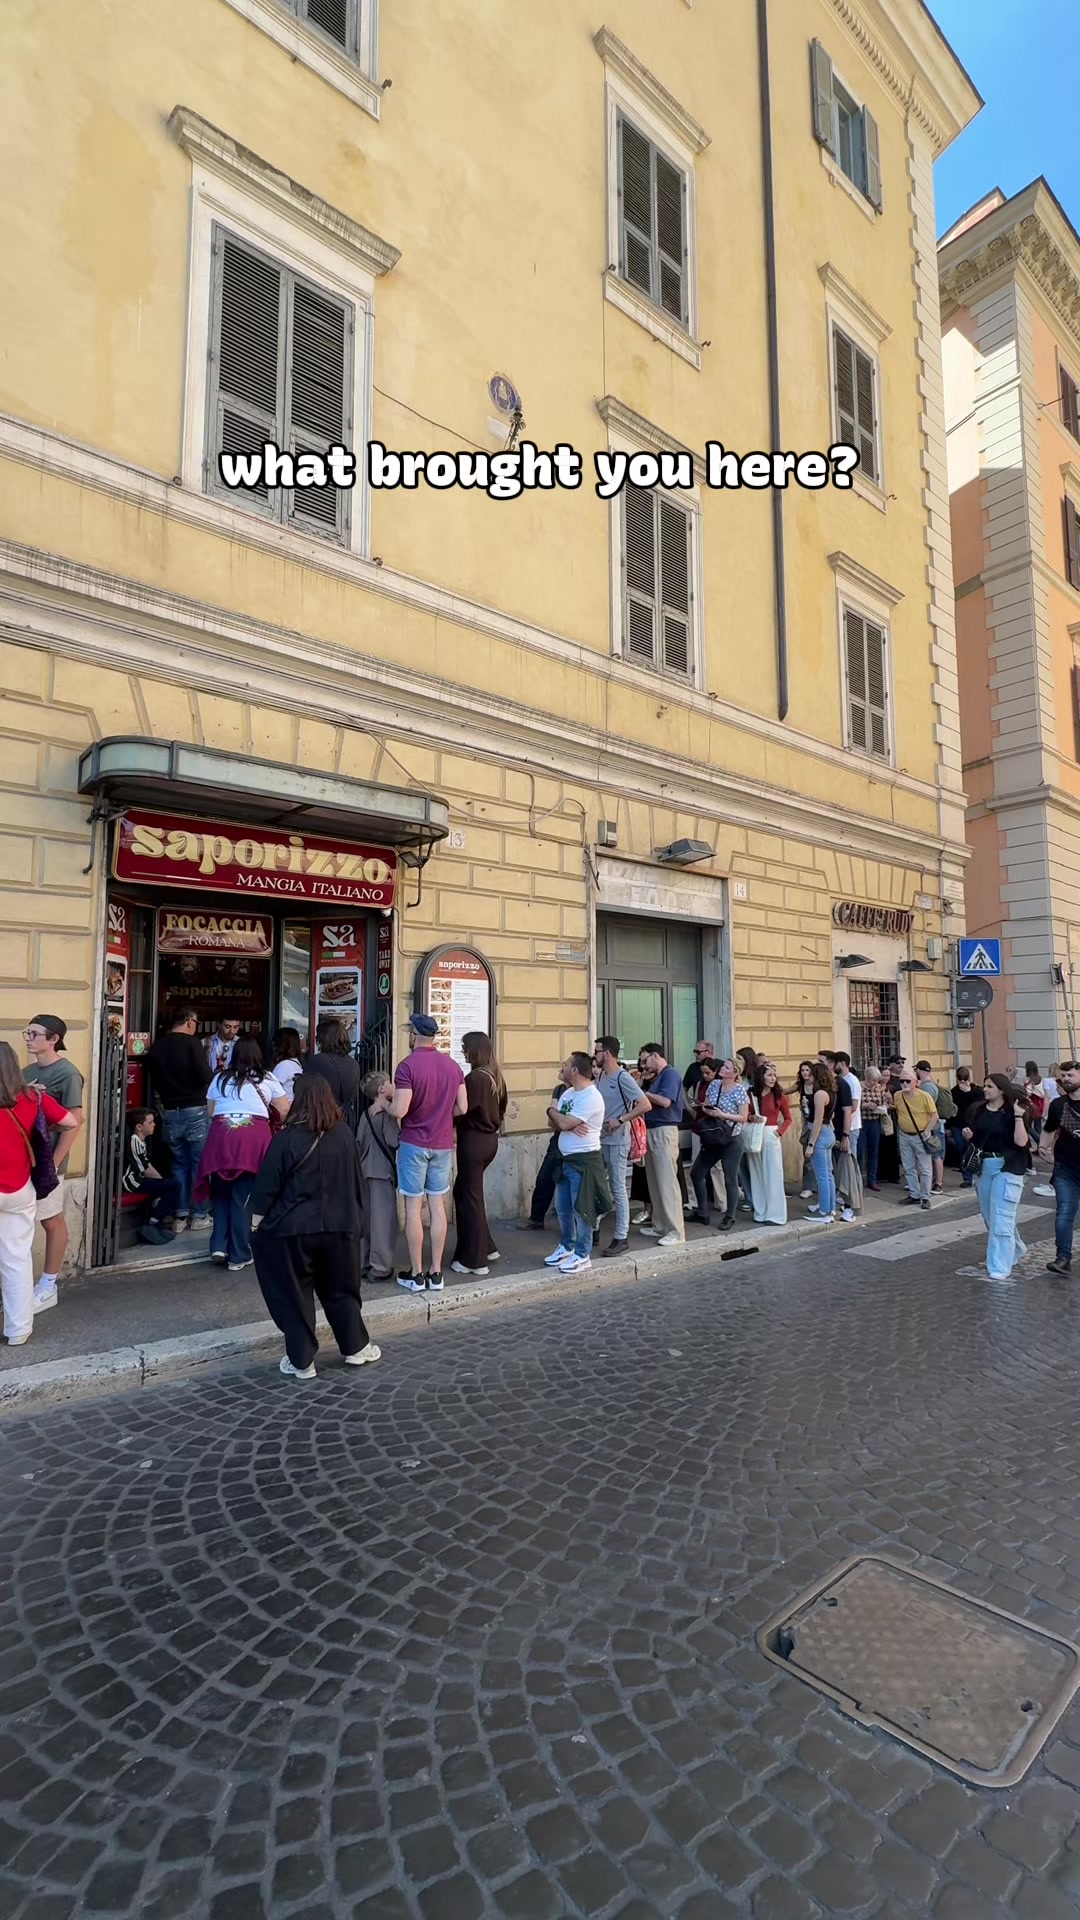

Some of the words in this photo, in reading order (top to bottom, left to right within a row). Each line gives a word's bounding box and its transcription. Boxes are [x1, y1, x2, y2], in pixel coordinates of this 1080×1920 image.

[449, 831, 463, 847] 13
[130, 824, 392, 886] saporizzo
[236, 872, 306, 893] MANGIA
[311, 882, 384, 901] ITALIANO
[735, 884, 745, 897] 14
[165, 913, 266, 936] FOCACCIA
[188, 935, 246, 948] ROMANA
[438, 960, 480, 970] saporizzo
[168, 984, 253, 999] saporizzo
[129, 1032, 149, 1040] ALSO
